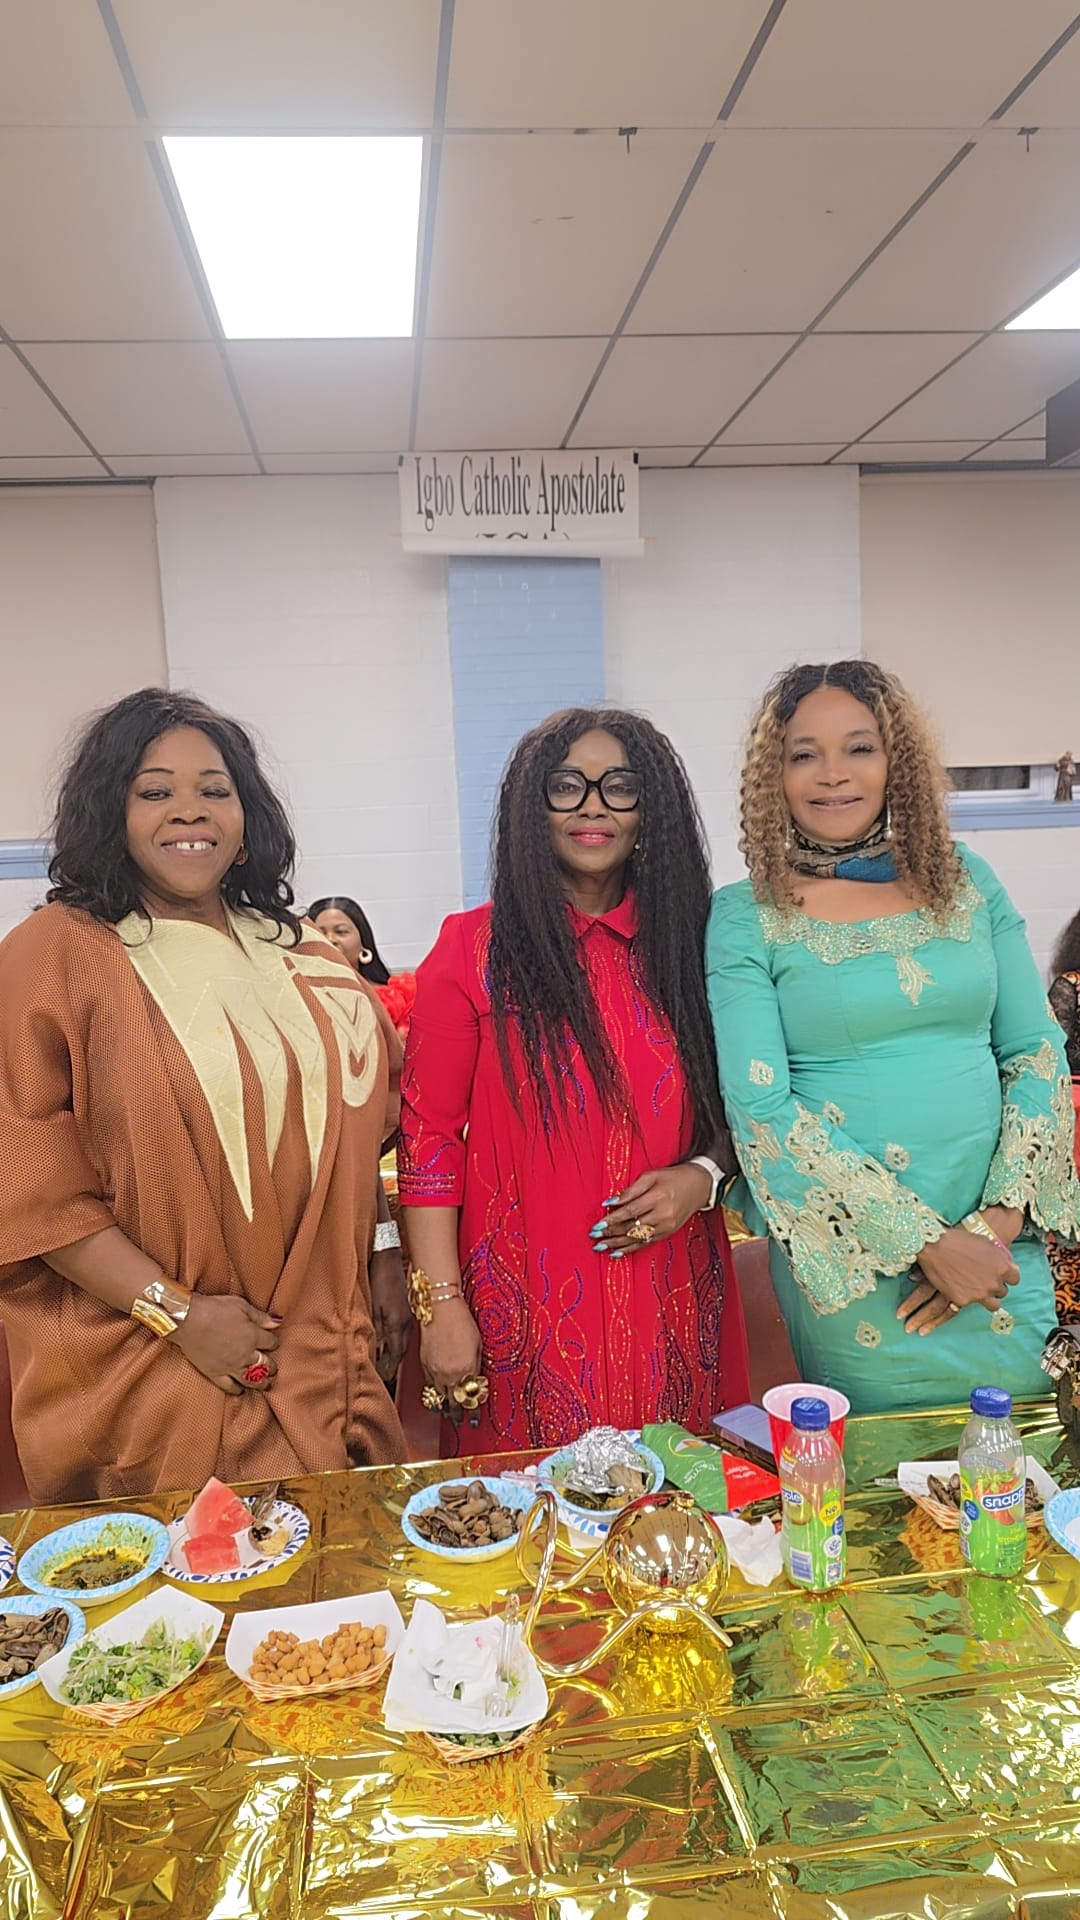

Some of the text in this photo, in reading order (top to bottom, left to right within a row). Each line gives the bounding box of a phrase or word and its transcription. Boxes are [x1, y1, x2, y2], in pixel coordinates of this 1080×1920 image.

[415, 455, 626, 532] Igbo Catholic Apostolate
